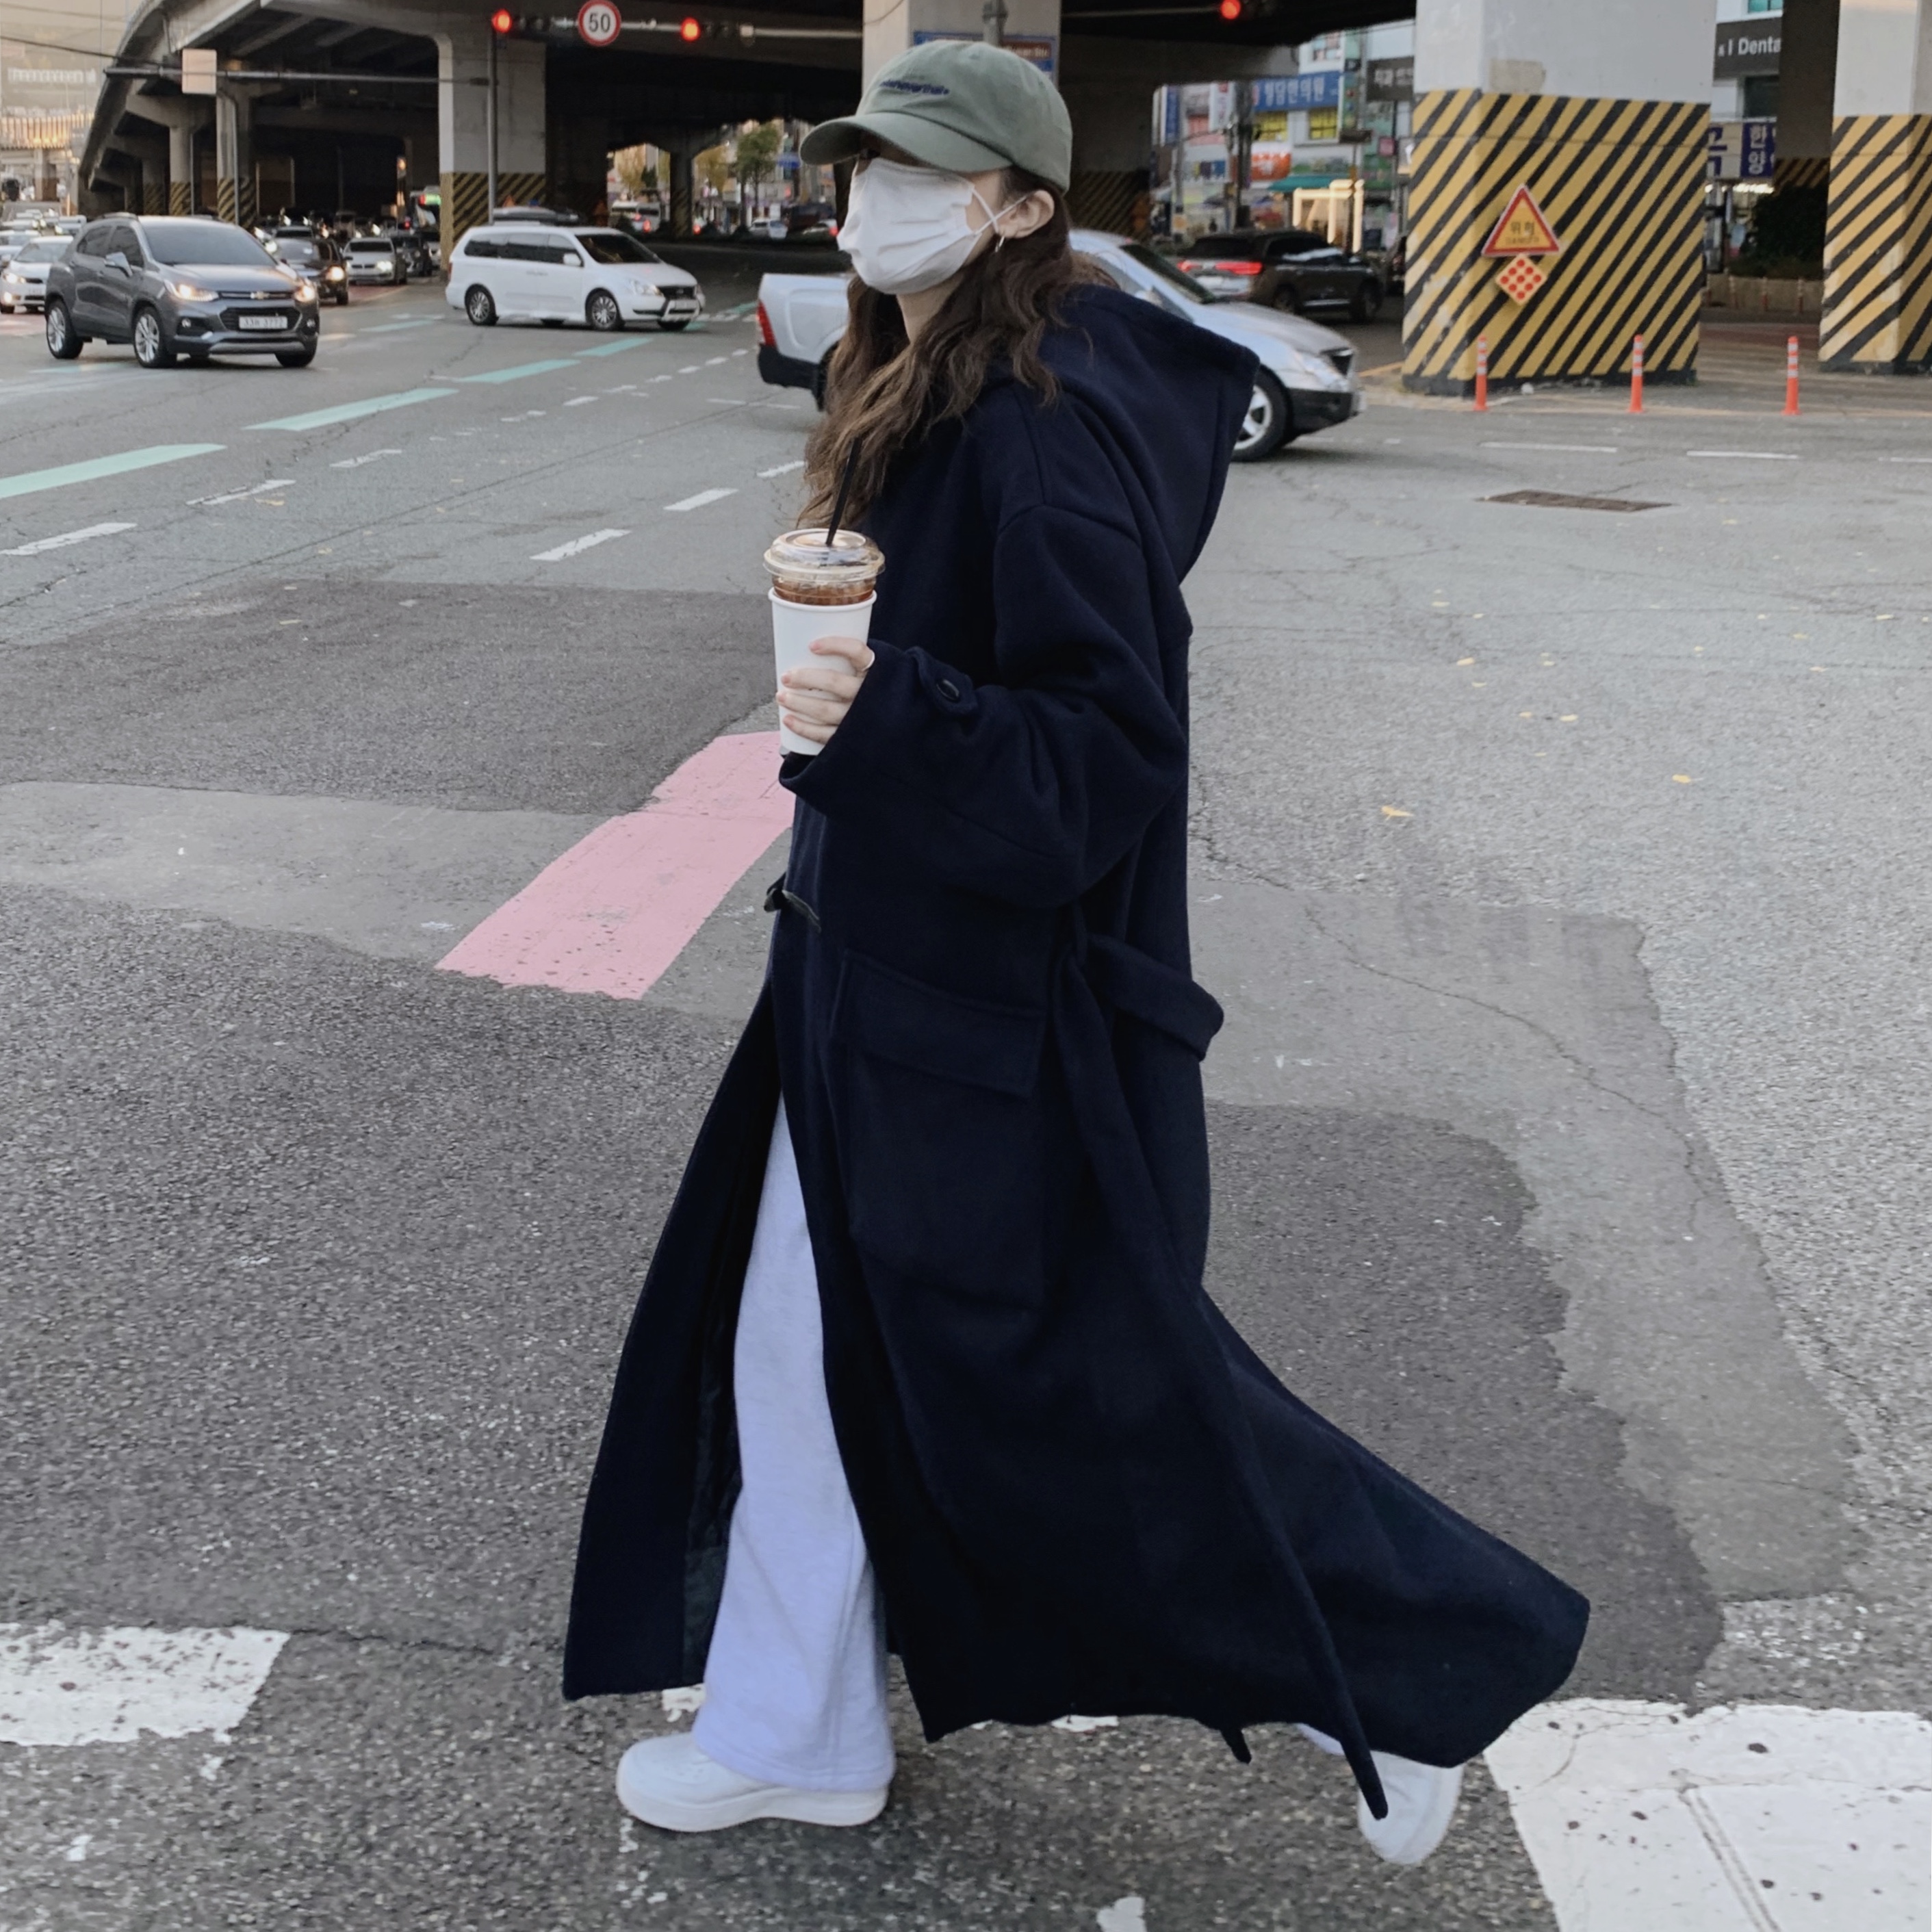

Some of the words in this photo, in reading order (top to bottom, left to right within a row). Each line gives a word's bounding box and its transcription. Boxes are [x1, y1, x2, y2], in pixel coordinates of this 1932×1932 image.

[589, 12, 610, 33] 50
[1750, 125, 1776, 149] 한
[1748, 151, 1775, 175] 양
